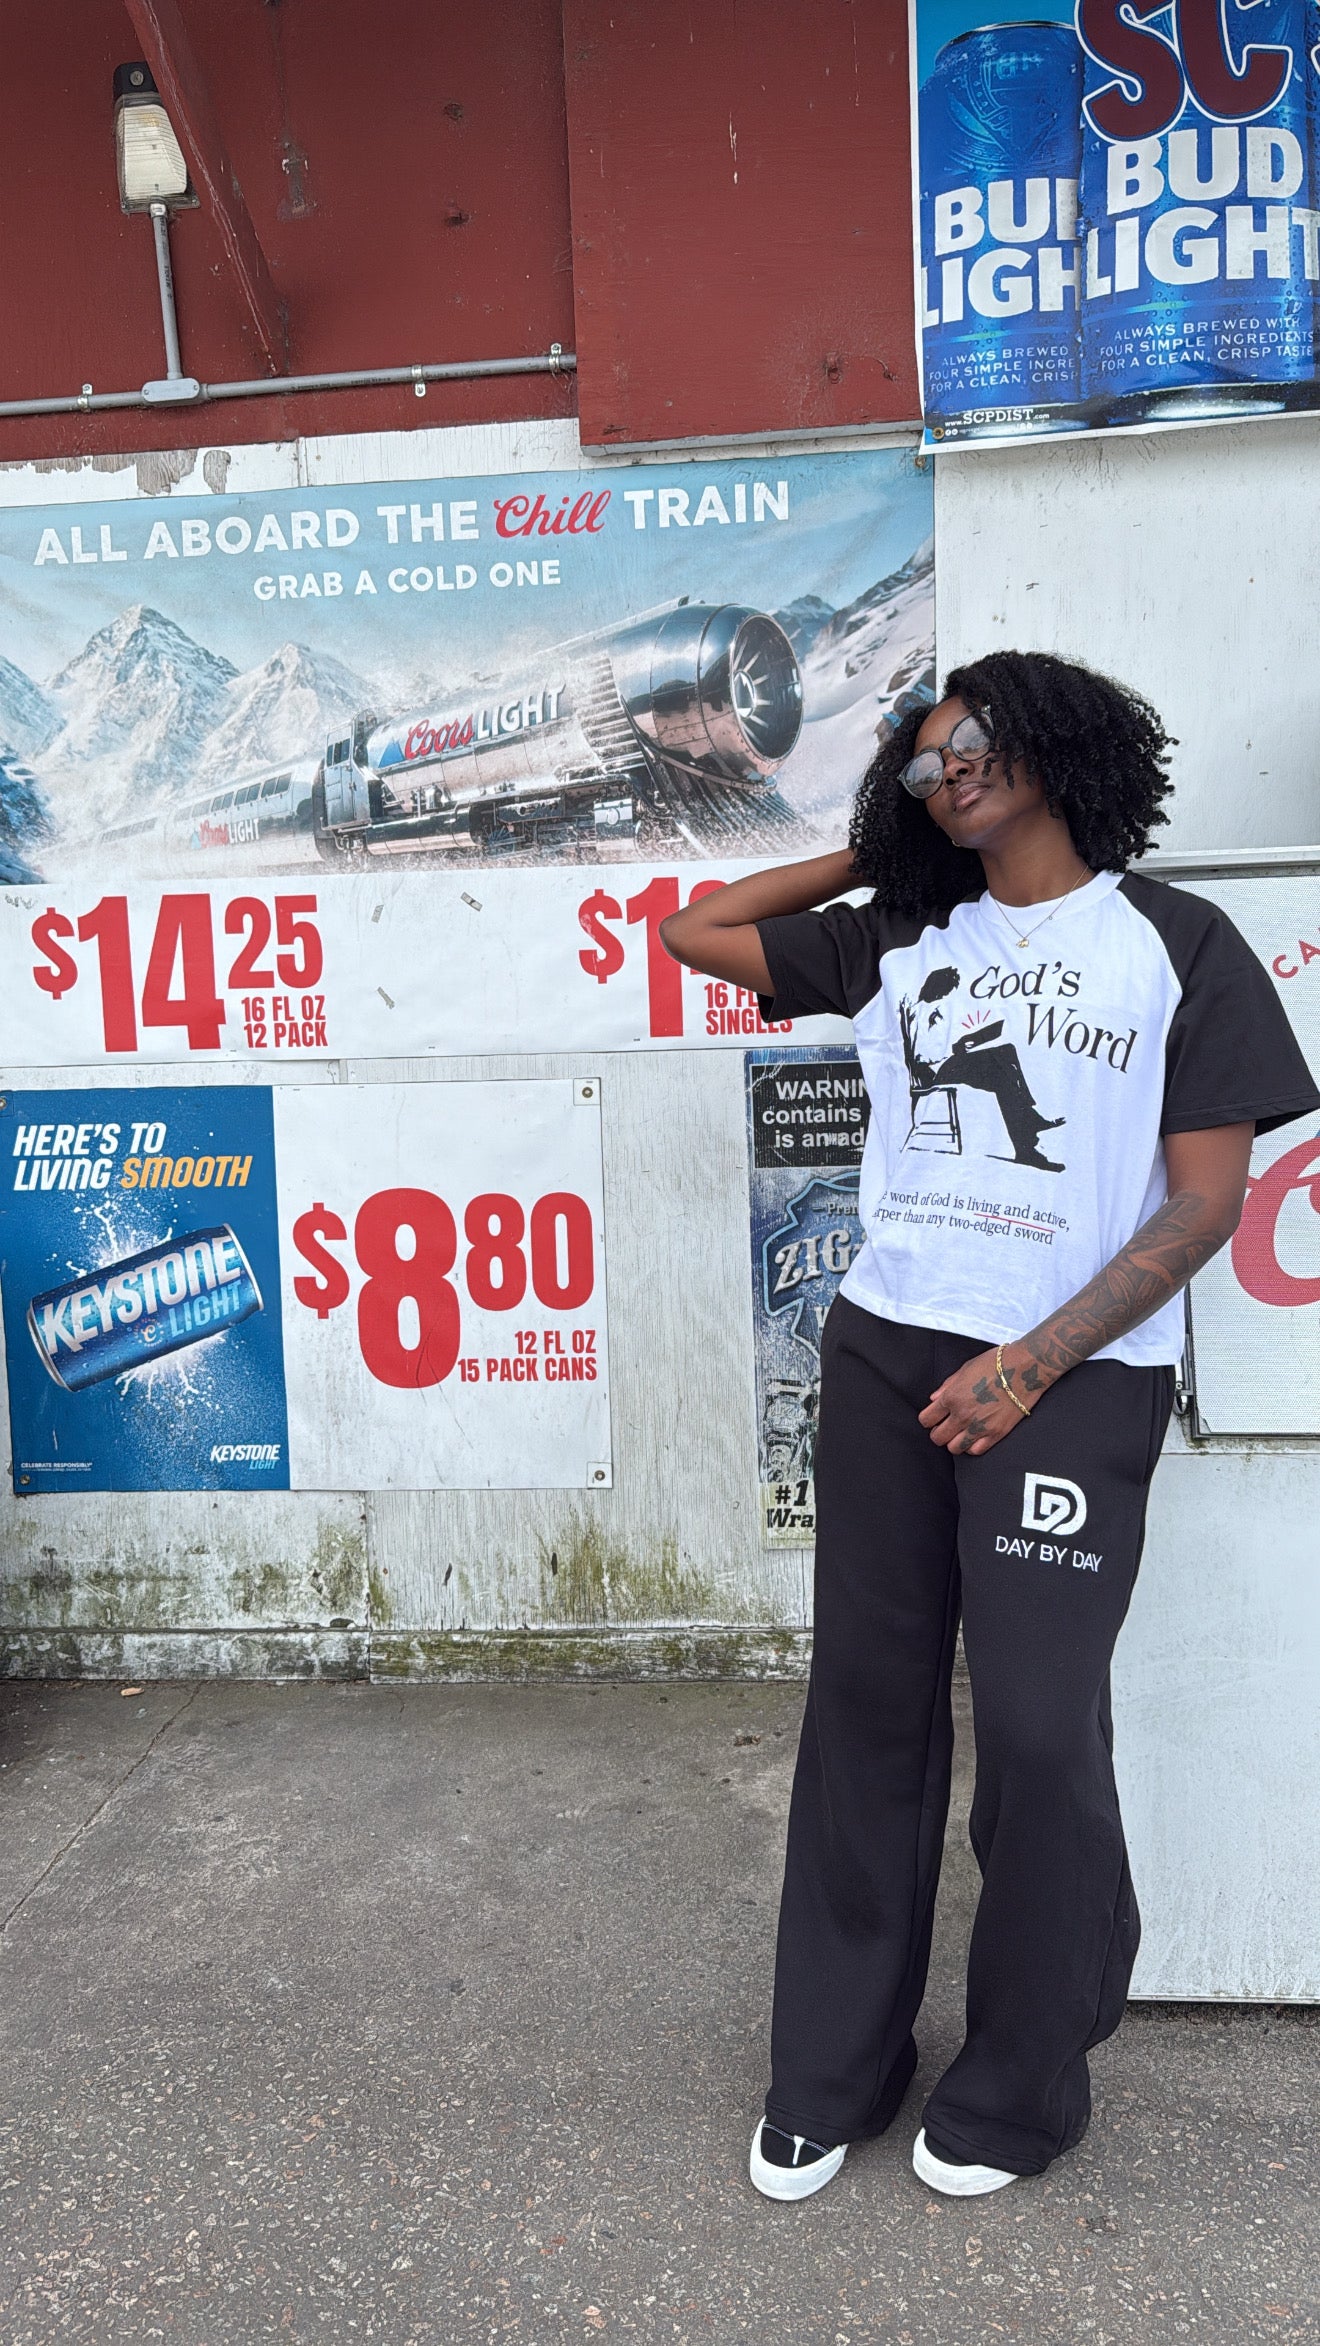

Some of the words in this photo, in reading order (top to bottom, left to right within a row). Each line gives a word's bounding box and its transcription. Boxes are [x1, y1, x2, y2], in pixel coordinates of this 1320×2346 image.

[1107, 127, 1303, 216] BUD
[1086, 206, 1320, 300] LIGHT
[1114, 324, 1176, 341] ALWAYS
[1183, 318, 1260, 334] BREWED
[1266, 317, 1300, 329] WITH
[942, 350, 996, 367] ALWAYS
[1002, 346, 1069, 359] BREWED
[1100, 344, 1133, 357] FOUR
[1139, 336, 1206, 352] SIMPLE
[1214, 331, 1313, 346] INGREDIENTS
[929, 369, 959, 381] FOUR
[964, 360, 1022, 377] SIMPLE
[1101, 358, 1125, 372] FOR
[1130, 357, 1140, 368] A
[1146, 350, 1211, 366] CLEAN,
[1217, 347, 1271, 361] CRISP
[1276, 345, 1312, 356] TASTE
[931, 382, 952, 393] FOR
[956, 380, 965, 389] A
[970, 374, 1026, 388] CLEAN,
[33, 523, 128, 566] ALL
[143, 508, 360, 560] ABOARD
[377, 500, 480, 545] THE
[493, 489, 612, 538] Chill
[623, 481, 790, 530] TRAIN
[254, 572, 344, 601] GRAB
[354, 569, 378, 596] A
[388, 564, 478, 593] COLD
[489, 559, 561, 589] ONE
[404, 713, 474, 760] Coors
[475, 683, 566, 741] LIGHT
[1272, 927, 1320, 978] CA
[969, 961, 1082, 999] God's
[241, 997, 265, 1022] 16
[272, 996, 295, 1021] FL
[301, 995, 326, 1021] OZ
[704, 982, 728, 1008] 16
[244, 1024, 267, 1048] 12
[275, 1021, 328, 1048] PACK
[1026, 1002, 1138, 1074] Word
[762, 1104, 862, 1126] contains
[12, 1122, 121, 1156] HERE'S
[129, 1122, 166, 1153] TO
[775, 1129, 794, 1148] is
[14, 1158, 111, 1191] LIVING
[121, 1156, 252, 1188] SMOOTH
[890, 1191, 919, 1206] word
[920, 1193, 931, 1206] of
[931, 1193, 950, 1207] God
[953, 1195, 964, 1210] is
[967, 1196, 1001, 1216] living
[1004, 1204, 1031, 1219] and
[1032, 1208, 1070, 1232] active,
[903, 1211, 924, 1224] than
[926, 1213, 945, 1228] any
[949, 1214, 1012, 1237] two-edged
[1014, 1226, 1053, 1245] sword
[41, 1235, 241, 1354] KEYSTONE
[168, 1279, 242, 1338] LIGHT
[514, 1331, 538, 1355] 12
[544, 1330, 566, 1354] FL
[572, 1329, 597, 1354] OZ
[457, 1359, 480, 1383] 15
[487, 1358, 539, 1382] PACK
[545, 1356, 597, 1381] CANS
[210, 1444, 281, 1463] KEYSTONE
[249, 1460, 277, 1470] LIGHT
[775, 1480, 809, 1506] #1
[767, 1508, 816, 1533] Wra
[995, 1535, 1035, 1559] DAY
[1039, 1543, 1068, 1565] BY
[1072, 1550, 1103, 1573] DAY
